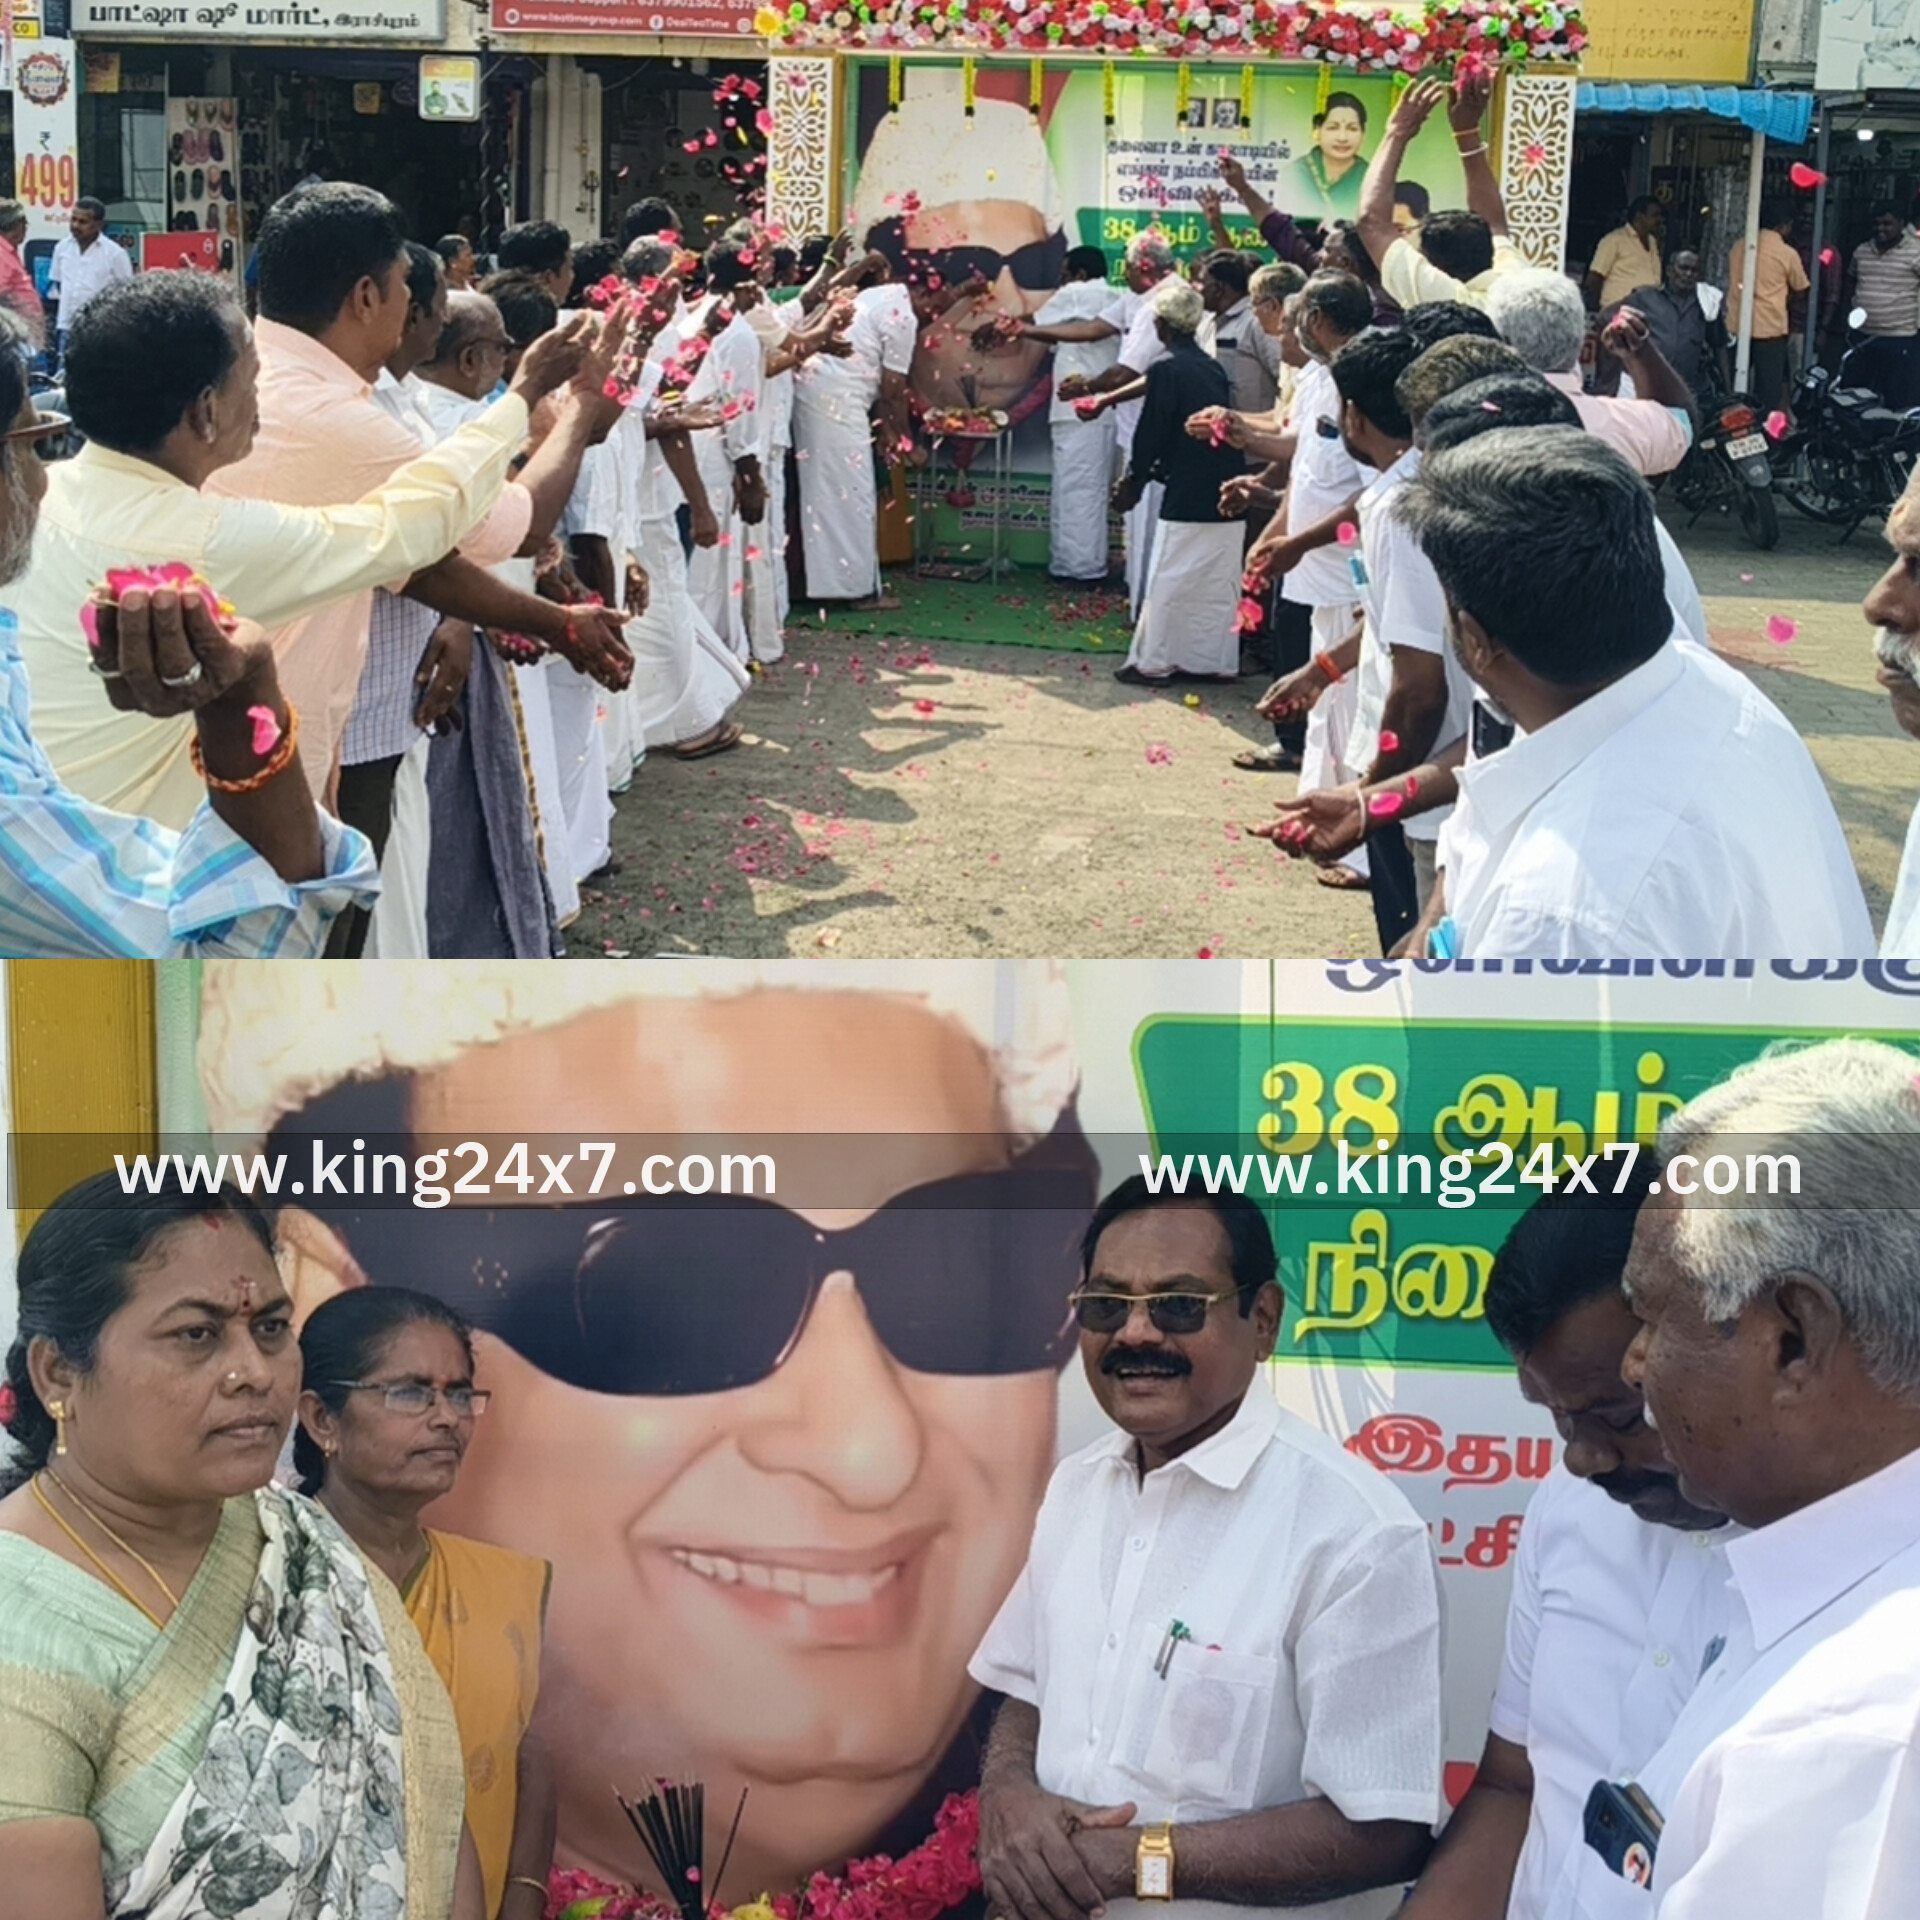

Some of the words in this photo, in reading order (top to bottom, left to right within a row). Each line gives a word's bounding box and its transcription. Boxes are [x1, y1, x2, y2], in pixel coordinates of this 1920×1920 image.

[90, 4, 189, 27] பாட்ஷா
[196, 2, 238, 28] ஷூ
[246, 2, 330, 28] மார்ட்,
[334, 12, 420, 29] இராசிபுரம்
[1107, 139, 1168, 155] தலைவா
[1171, 136, 1203, 155] உன்
[20, 153, 75, 208] 499
[1258, 1062, 1400, 1157] 38
